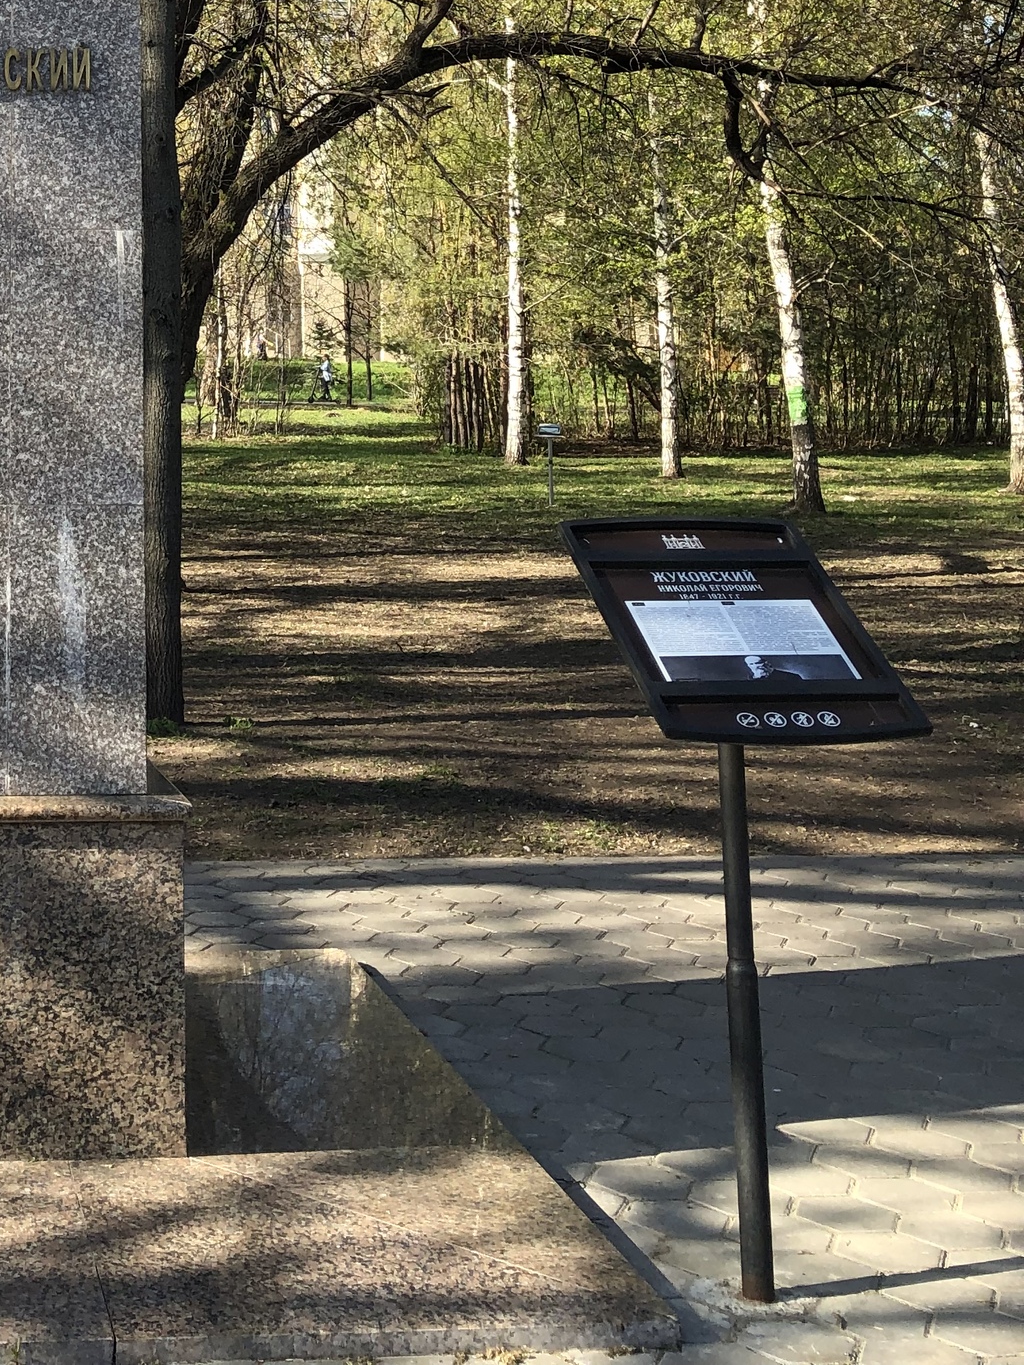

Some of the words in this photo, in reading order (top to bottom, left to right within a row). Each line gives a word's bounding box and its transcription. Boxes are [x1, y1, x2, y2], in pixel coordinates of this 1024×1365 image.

[650, 569, 757, 582] ЖУКОВСКИЙ
[657, 584, 708, 592] НИКОЛАЙ
[709, 584, 763, 592] ЕГОРОВИЧ
